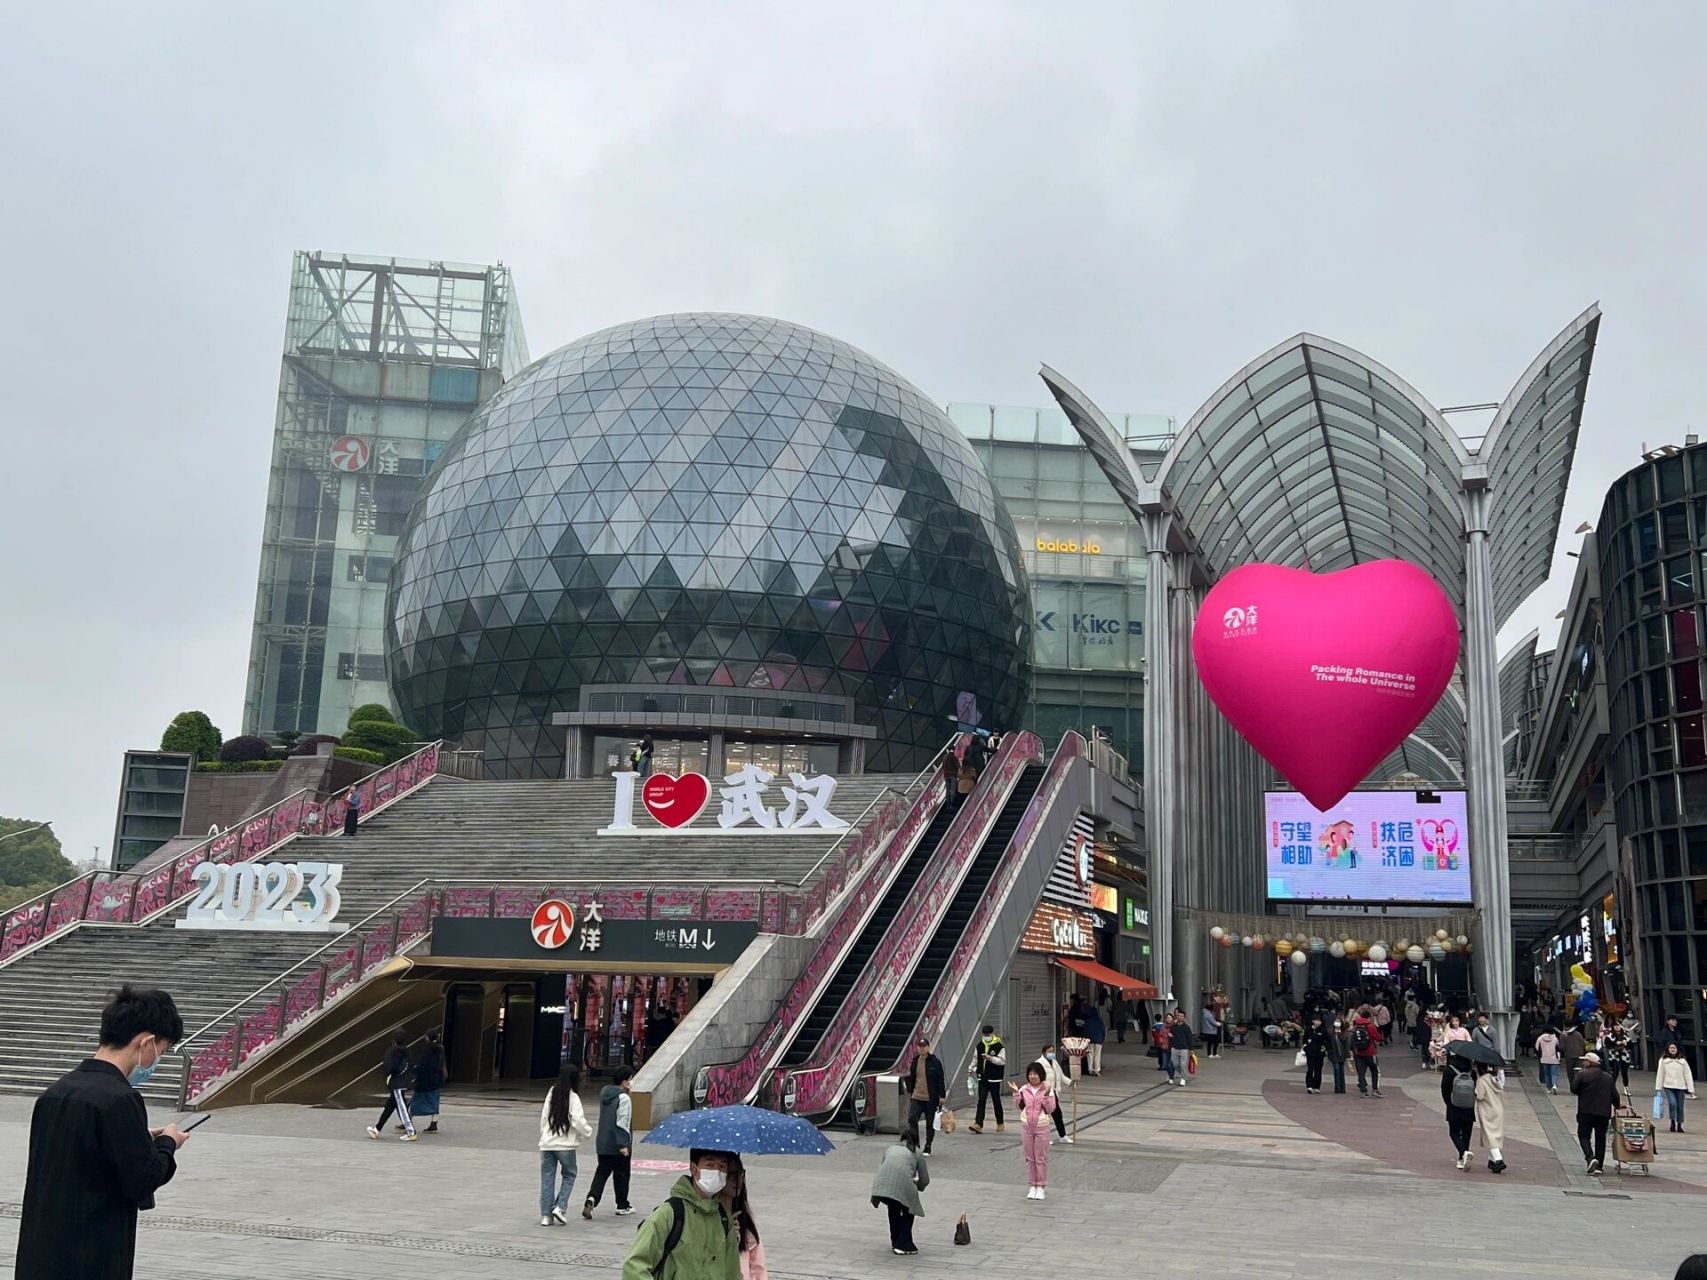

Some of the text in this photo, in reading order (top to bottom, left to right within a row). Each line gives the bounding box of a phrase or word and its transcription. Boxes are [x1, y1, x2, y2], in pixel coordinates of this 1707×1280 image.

[379, 440, 400, 475] 大洋
[1310, 664, 1416, 682] Packing Romance in
[1315, 672, 1416, 691] The whole Universe
[607, 763, 851, 830] I 武汉
[1280, 822, 1312, 842] 守望
[1380, 822, 1414, 842] 扶危
[1281, 845, 1312, 865] 相助
[1382, 845, 1414, 867] 济困
[186, 861, 332, 923] 2023
[579, 900, 604, 952] 大洋
[655, 928, 678, 942] 地铁
